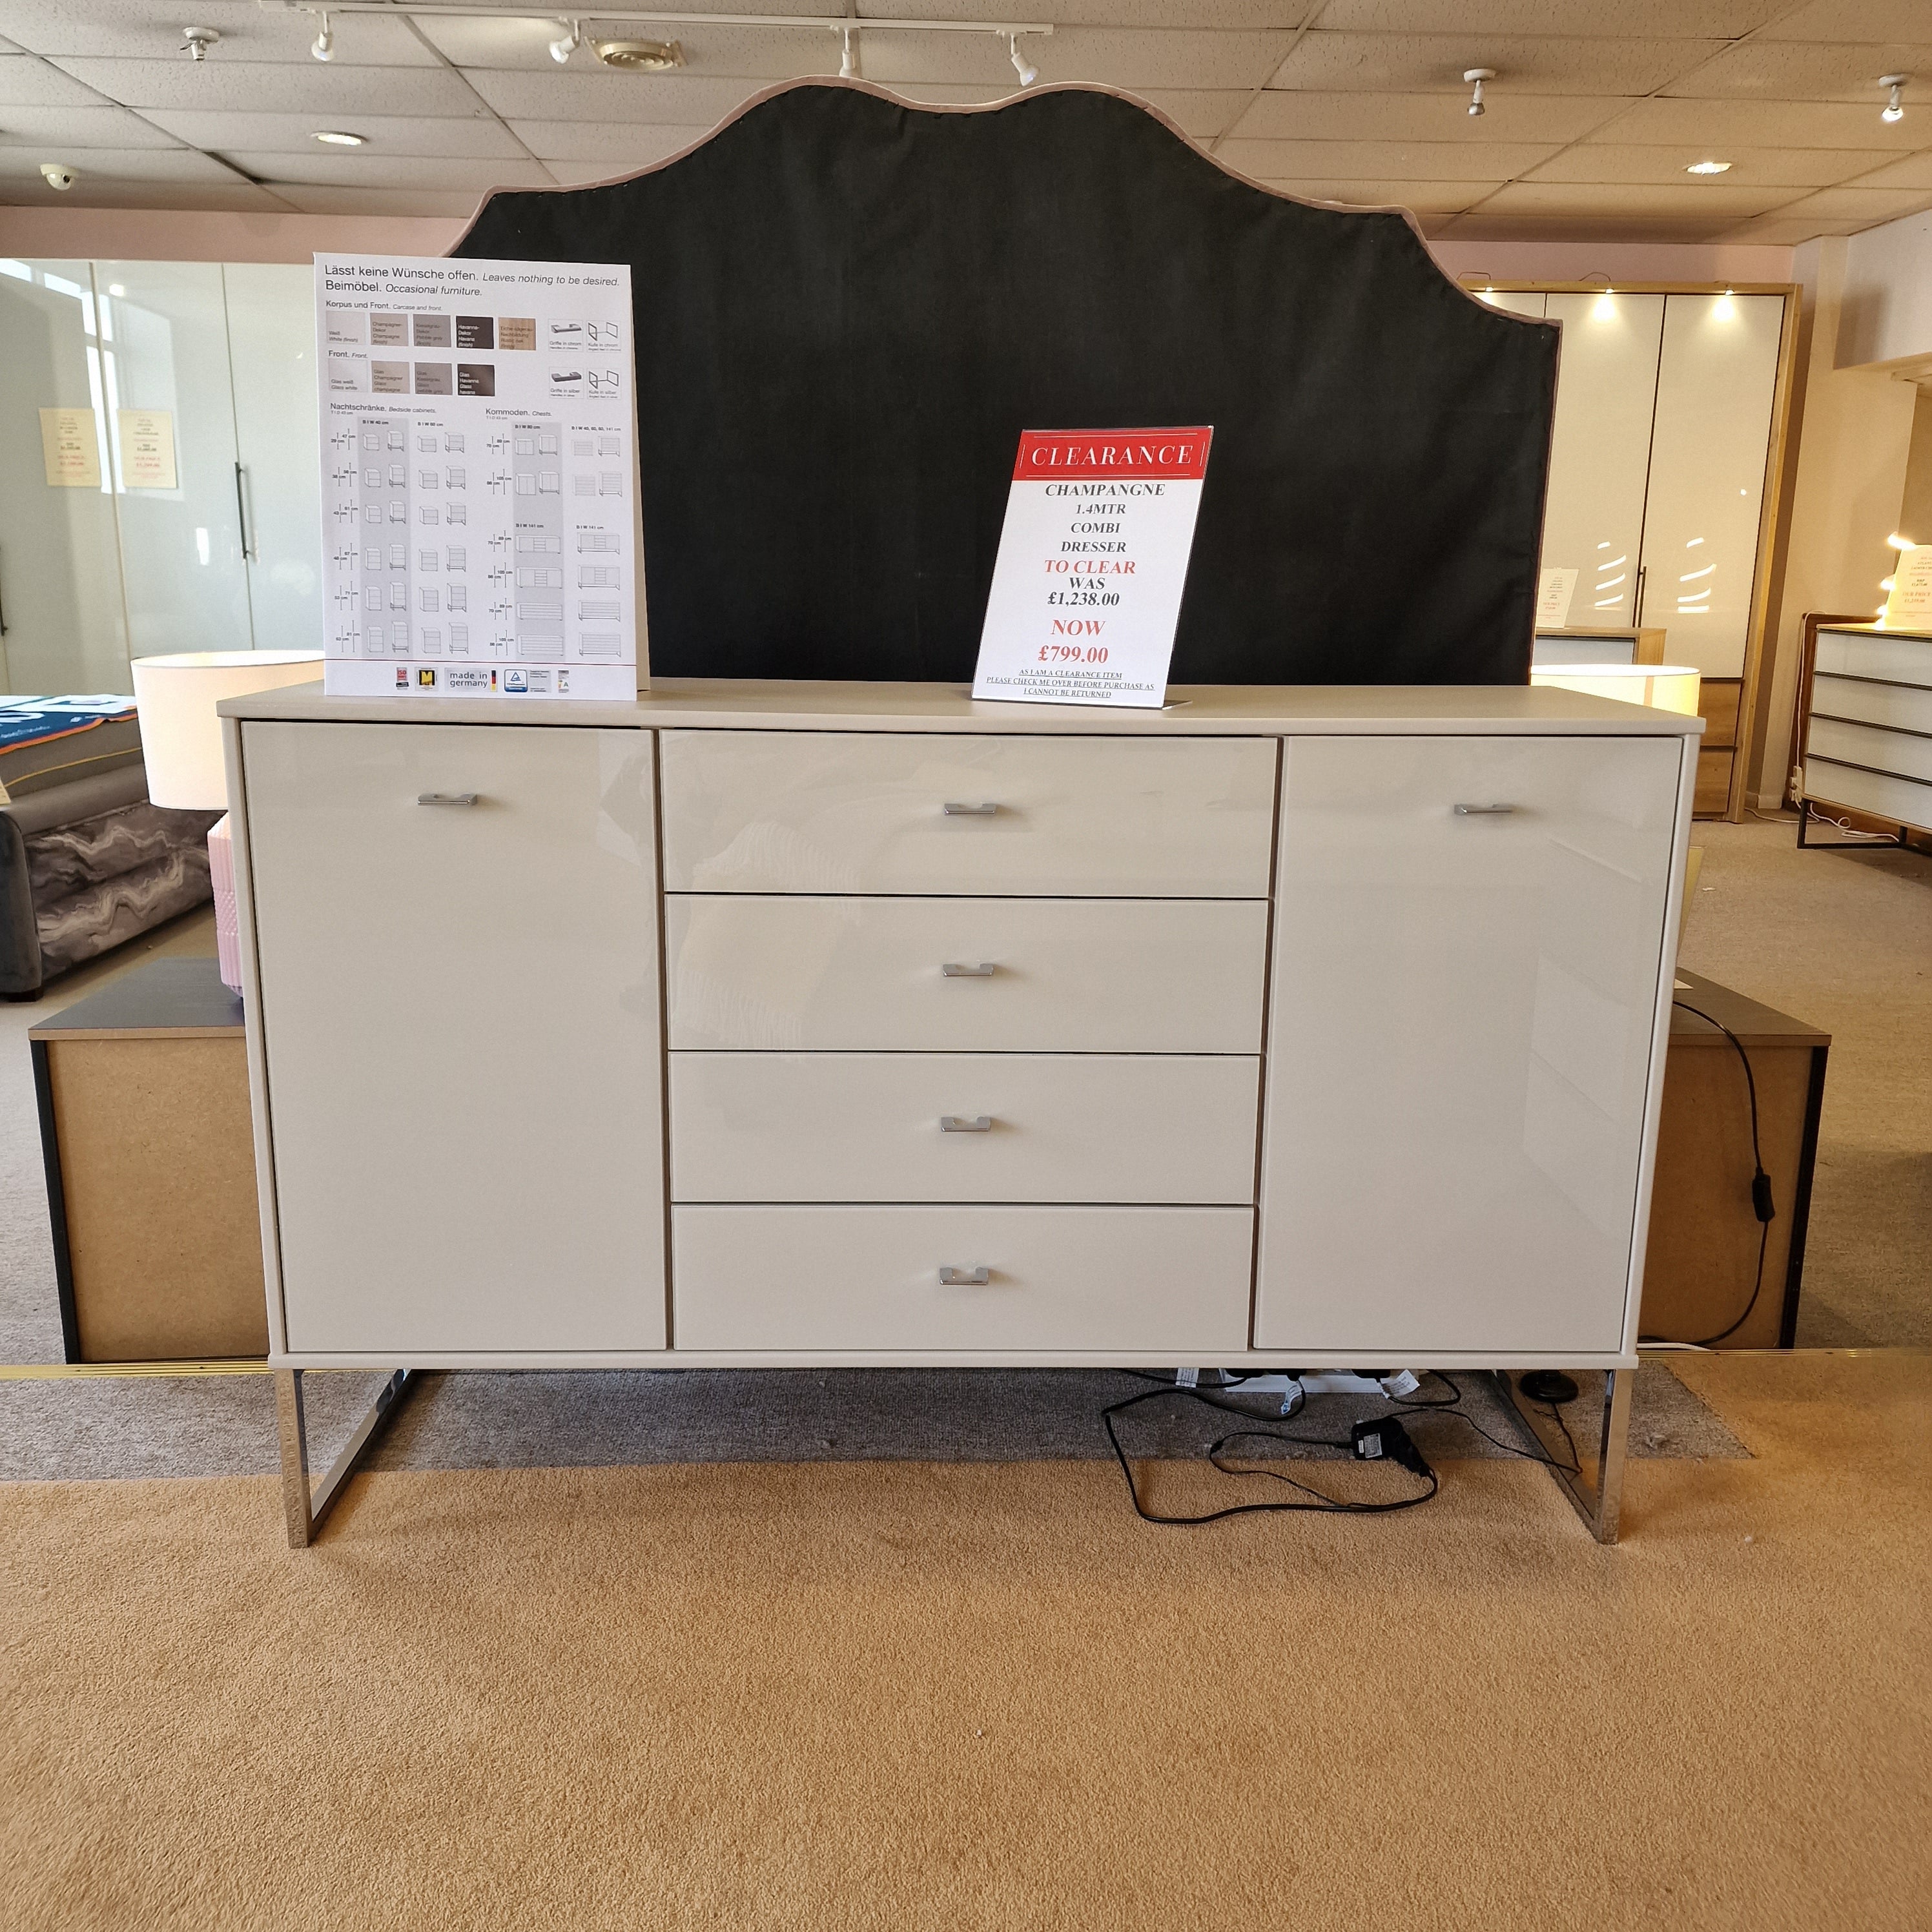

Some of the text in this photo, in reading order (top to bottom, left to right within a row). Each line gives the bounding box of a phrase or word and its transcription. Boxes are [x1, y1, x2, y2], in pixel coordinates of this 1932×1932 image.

[325, 265, 620, 286] Lässt keine Wünsche offen. Leaves nothing to be desired.
[325, 280, 482, 296] Beimöbel. Occasional furniture.
[325, 300, 352, 309] Korpus
[330, 403, 387, 412] Nachtschränke.
[486, 408, 530, 416] Kommoden.
[1032, 445, 1193, 466] CLEARANCE
[1045, 484, 1165, 496] CHAMPANGNE
[1076, 504, 1125, 514] 1.4MTR
[1071, 522, 1120, 533] COMBI
[1060, 542, 1126, 552] DRESSER
[1044, 560, 1136, 574] TO CLEAR
[1069, 577, 1105, 590] WAS
[1047, 592, 1120, 606] £1,238.00
[1051, 620, 1105, 636] NOW
[1038, 645, 1109, 663] £799.00
[449, 679, 488, 688] germany
[987, 676, 1012, 684] PLEASE
[1071, 690, 1111, 698] RETURNED
